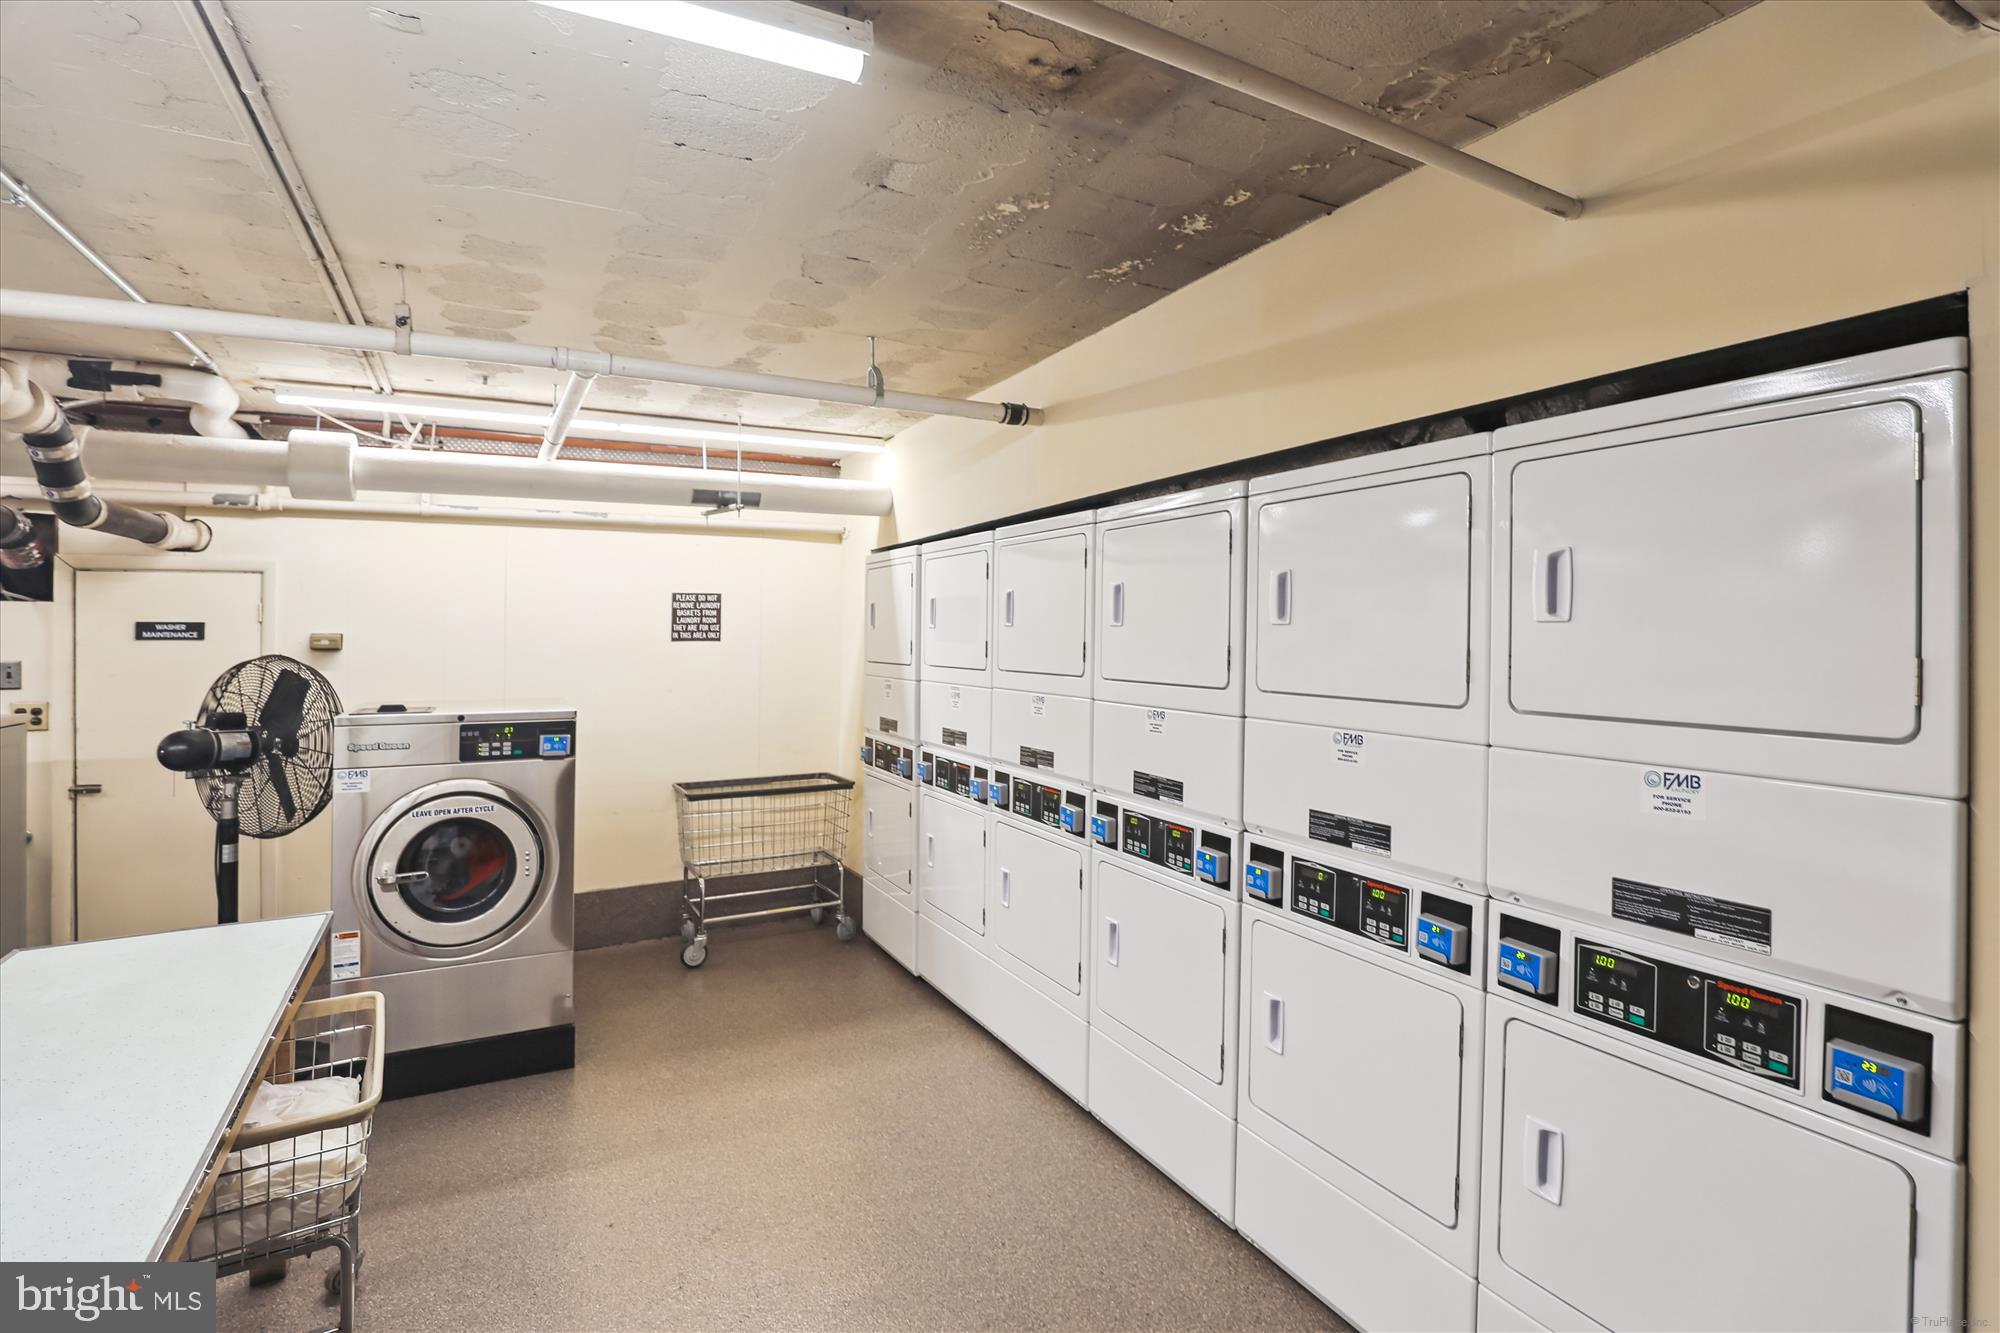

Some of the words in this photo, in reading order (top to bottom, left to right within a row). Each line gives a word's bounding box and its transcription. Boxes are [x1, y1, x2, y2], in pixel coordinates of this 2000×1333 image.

[1343, 732, 1363, 745] FMB
[347, 742, 379, 752] Speed
[379, 742, 410, 750] Queen
[1663, 772, 1701, 790] FMB
[1716, 980, 1749, 995] Speed
[1749, 988, 1784, 1005] Queen
[1862, 1060, 1877, 1073] 23
